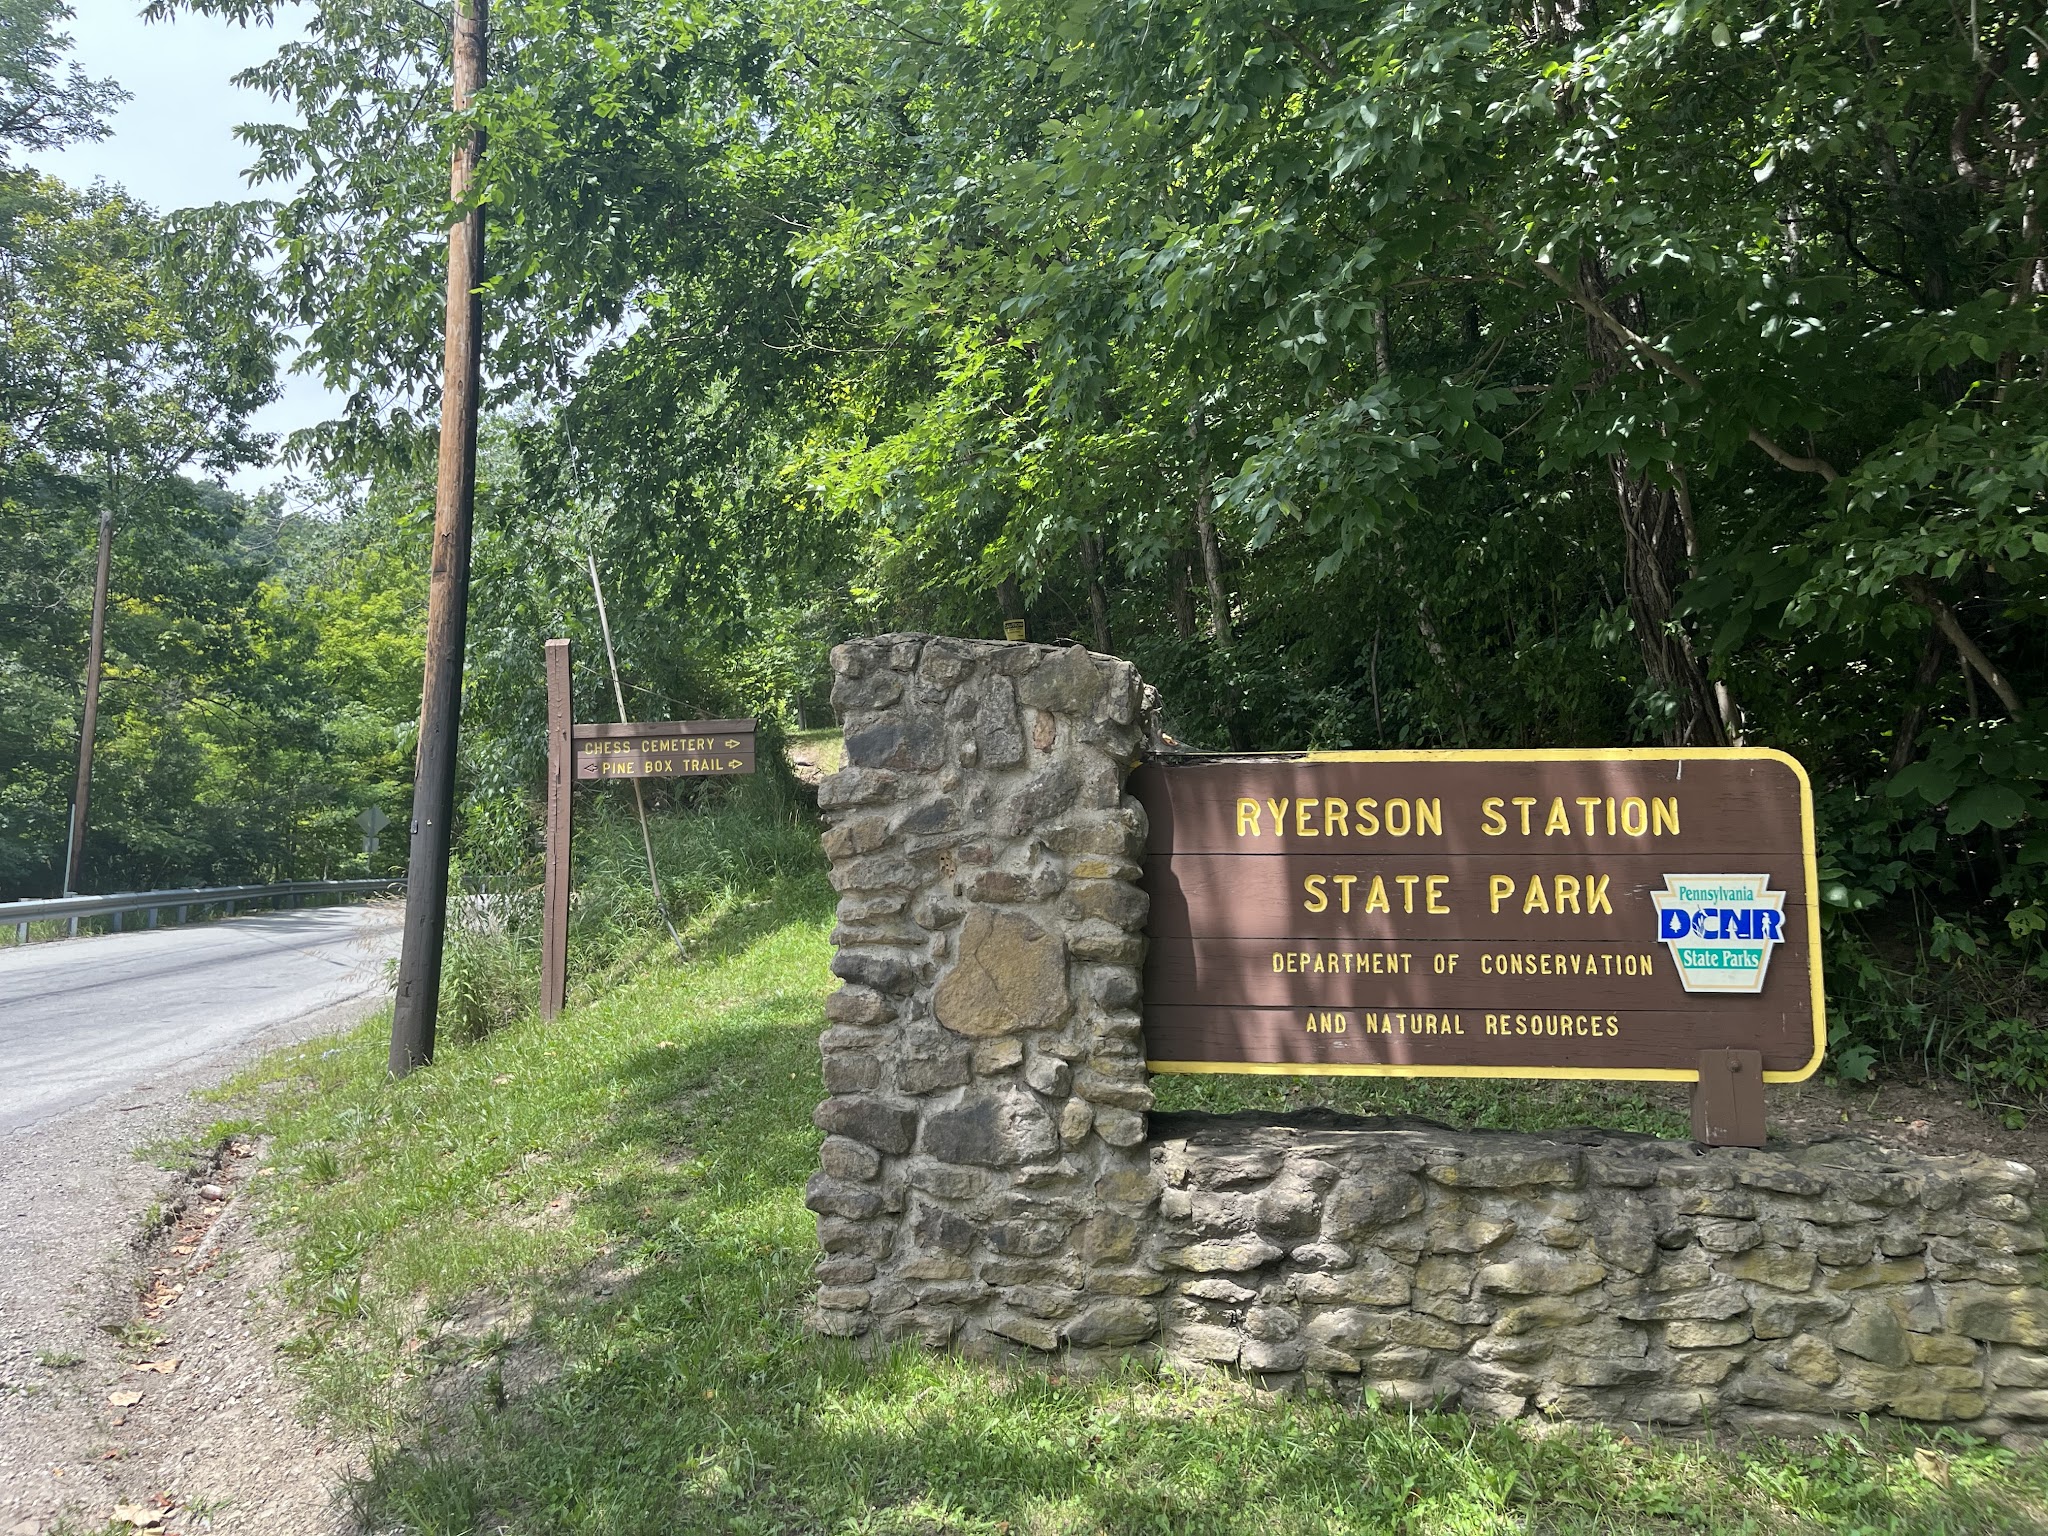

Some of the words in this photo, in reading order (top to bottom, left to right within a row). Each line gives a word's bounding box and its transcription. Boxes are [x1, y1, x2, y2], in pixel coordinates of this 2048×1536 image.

[585, 741, 631, 755] CHESS
[641, 738, 715, 753] CEMETERY
[602, 761, 634, 774] PINE
[645, 760, 673, 774] BOX
[683, 758, 723, 772] TRAIL
[1236, 797, 1443, 838] RYERSON
[1481, 796, 1681, 837] STATION
[1303, 874, 1451, 915] STATE
[1489, 874, 1613, 916] PARK
[1679, 886, 1754, 904] Pennsylvania
[1661, 908, 1781, 940] DCNR
[1272, 952, 1412, 976] DEPARTMENT
[1433, 953, 1459, 976] OF
[1480, 953, 1654, 977] CONSERVATION
[1683, 950, 1719, 967] State
[1722, 950, 1759, 967] Parks
[1305, 1012, 1347, 1035] AND
[1366, 1013, 1465, 1036] NATURAL
[1485, 1014, 1620, 1038] RESOURCES
